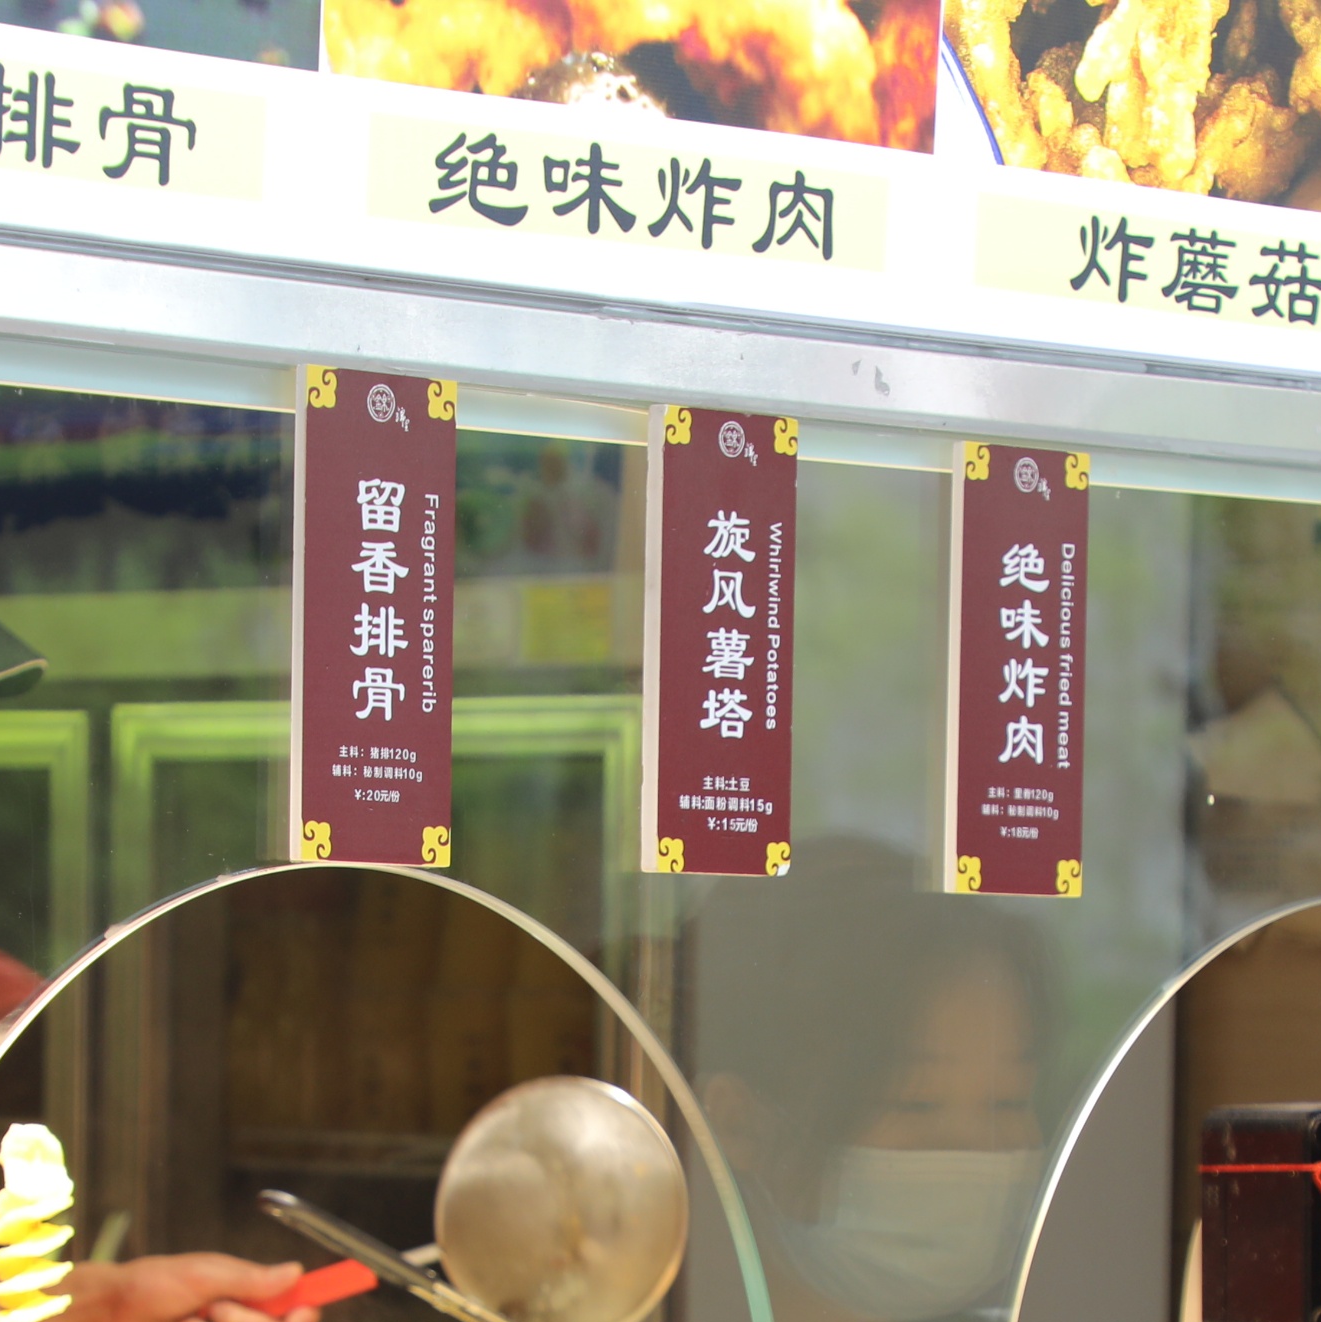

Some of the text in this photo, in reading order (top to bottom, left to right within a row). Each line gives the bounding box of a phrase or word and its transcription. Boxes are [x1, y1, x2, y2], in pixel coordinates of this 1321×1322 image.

[428, 132, 834, 261] 绝味炸肉
[350, 478, 410, 721] 留香排骨
[420, 493, 439, 713] Fragrant sparerib
[699, 510, 756, 739] 旋风薯塔
[765, 522, 783, 730] Whirlwind Potatoes
[998, 543, 1050, 765] 绝味炸肉
[1056, 543, 1076, 769] Delicious fried meat
